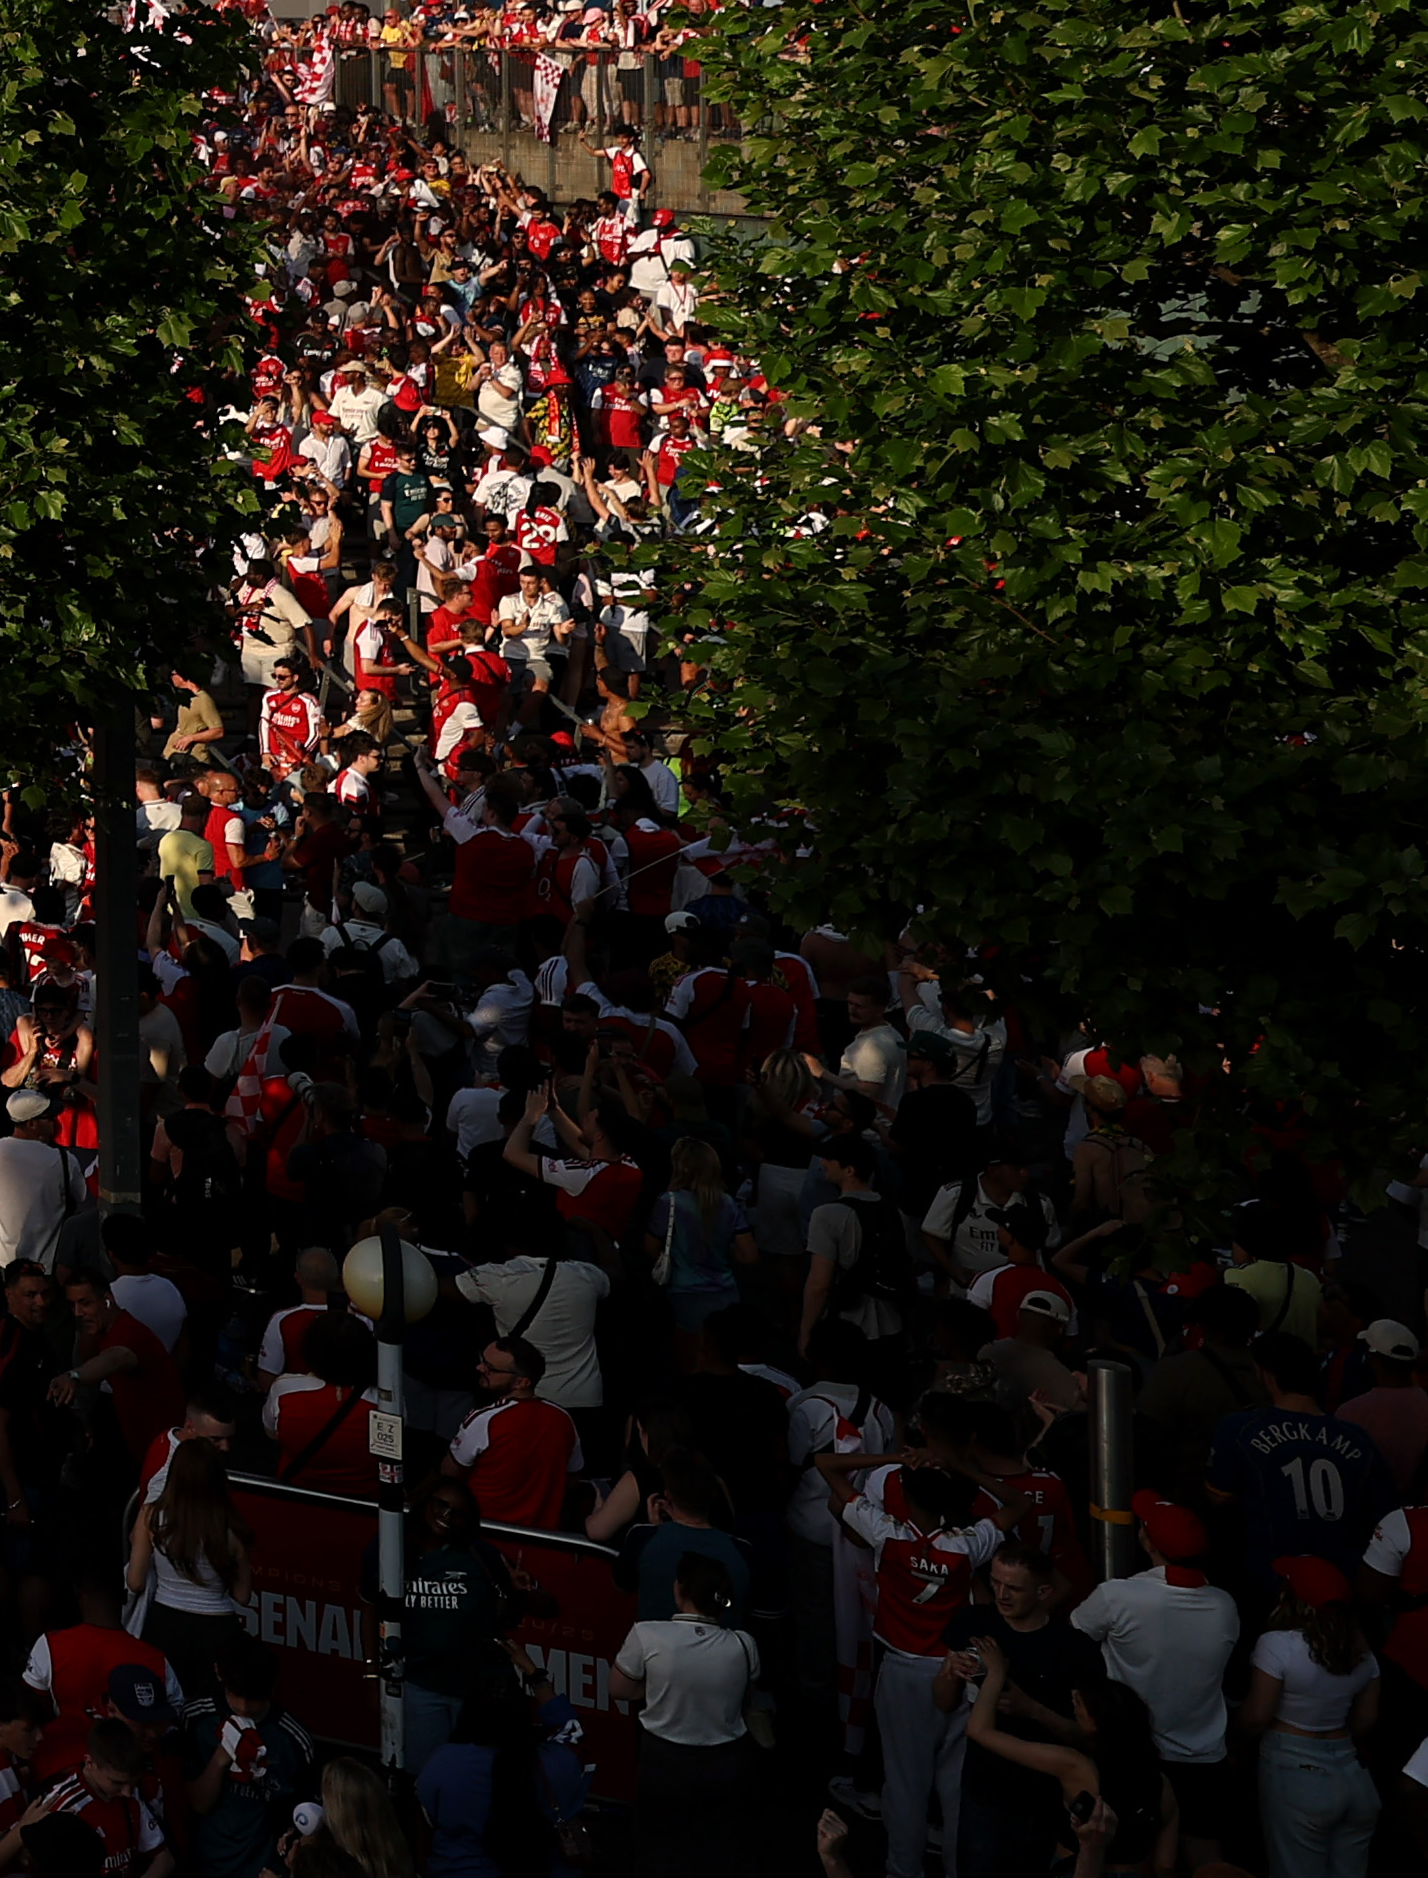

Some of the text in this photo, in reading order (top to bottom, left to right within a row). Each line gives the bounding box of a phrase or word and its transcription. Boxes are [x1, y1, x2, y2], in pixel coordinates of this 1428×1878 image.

[521, 522, 556, 549] 29
[377, 1433, 395, 1444] 025
[1250, 1421, 1363, 1463] BERGKAMP
[1279, 1457, 1345, 1522] 10
[910, 1556, 949, 1576] SAKA
[911, 1570, 945, 1604] 7
[405, 1595, 459, 1610] LY BETTER
